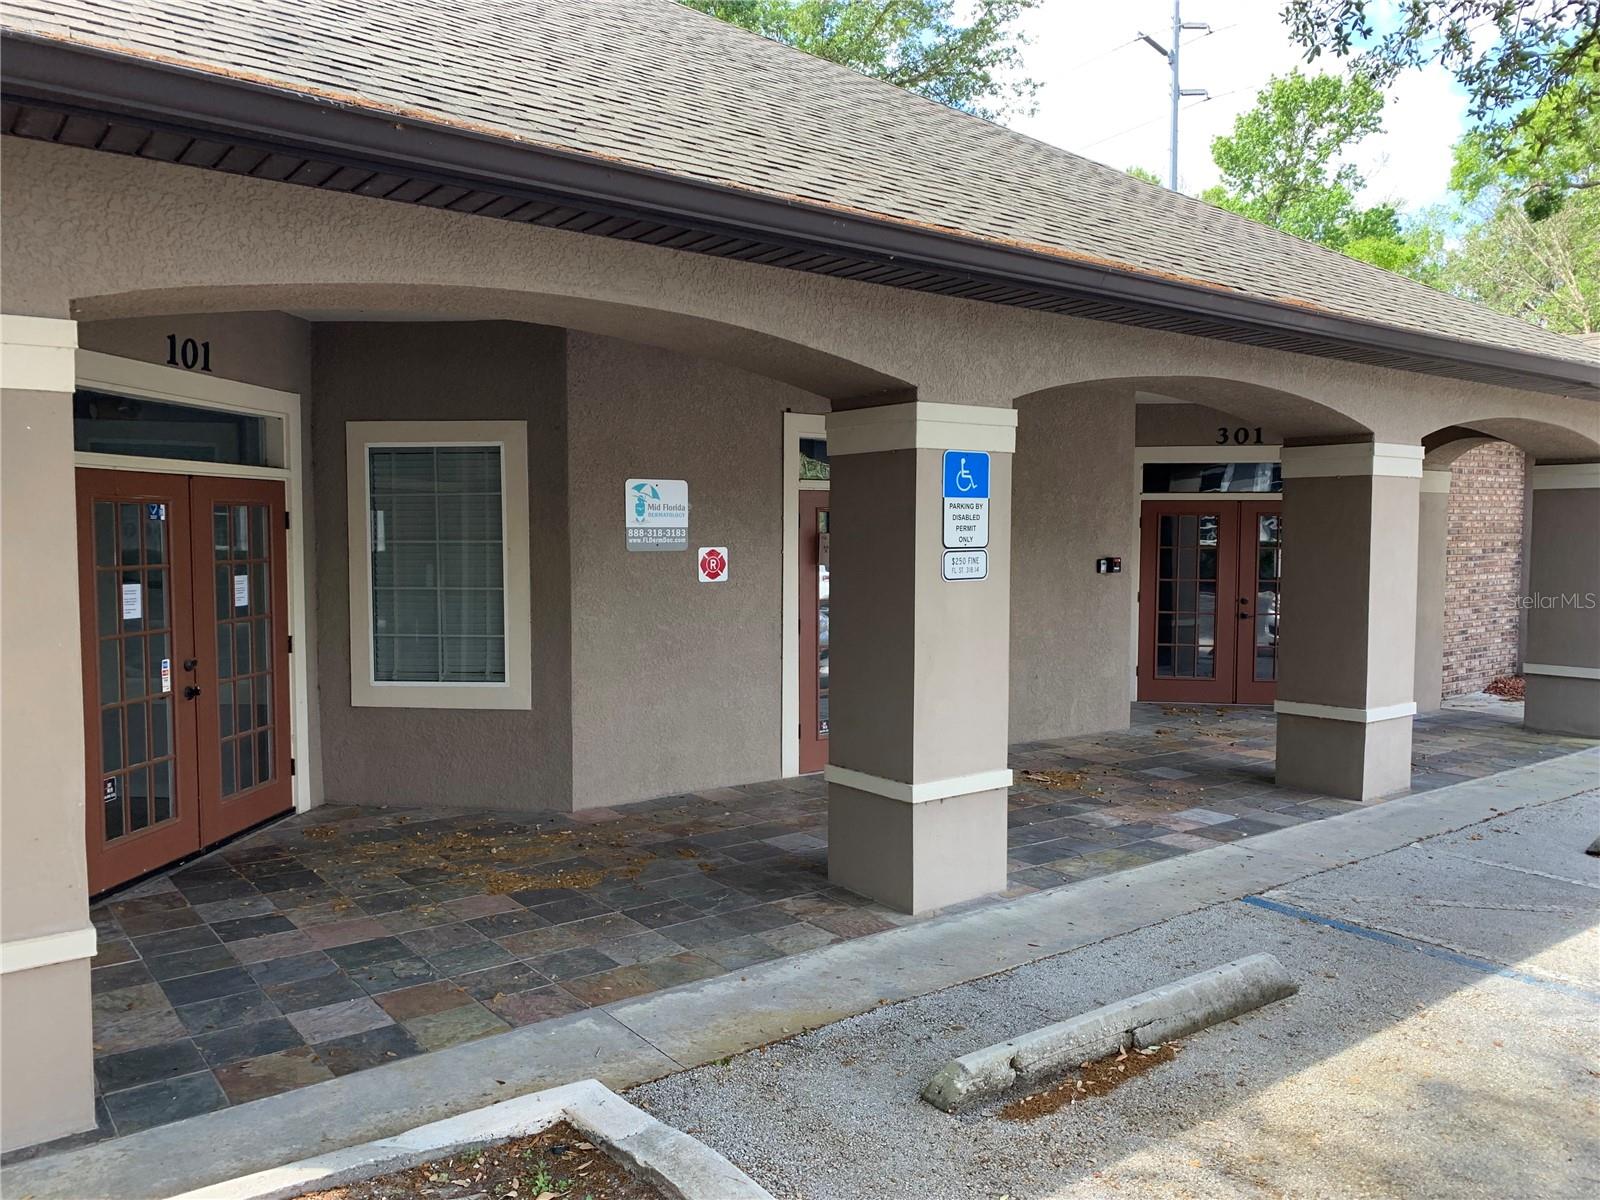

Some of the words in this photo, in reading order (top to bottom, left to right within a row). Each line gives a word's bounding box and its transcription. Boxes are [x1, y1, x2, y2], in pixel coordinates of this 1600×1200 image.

[166, 333, 212, 372] 101
[1215, 427, 1264, 445] 301
[628, 528, 686, 537] 888-318-3183
[710, 559, 717, 570] R
[951, 556, 967, 566] $250
[967, 556, 980, 565] FINE
